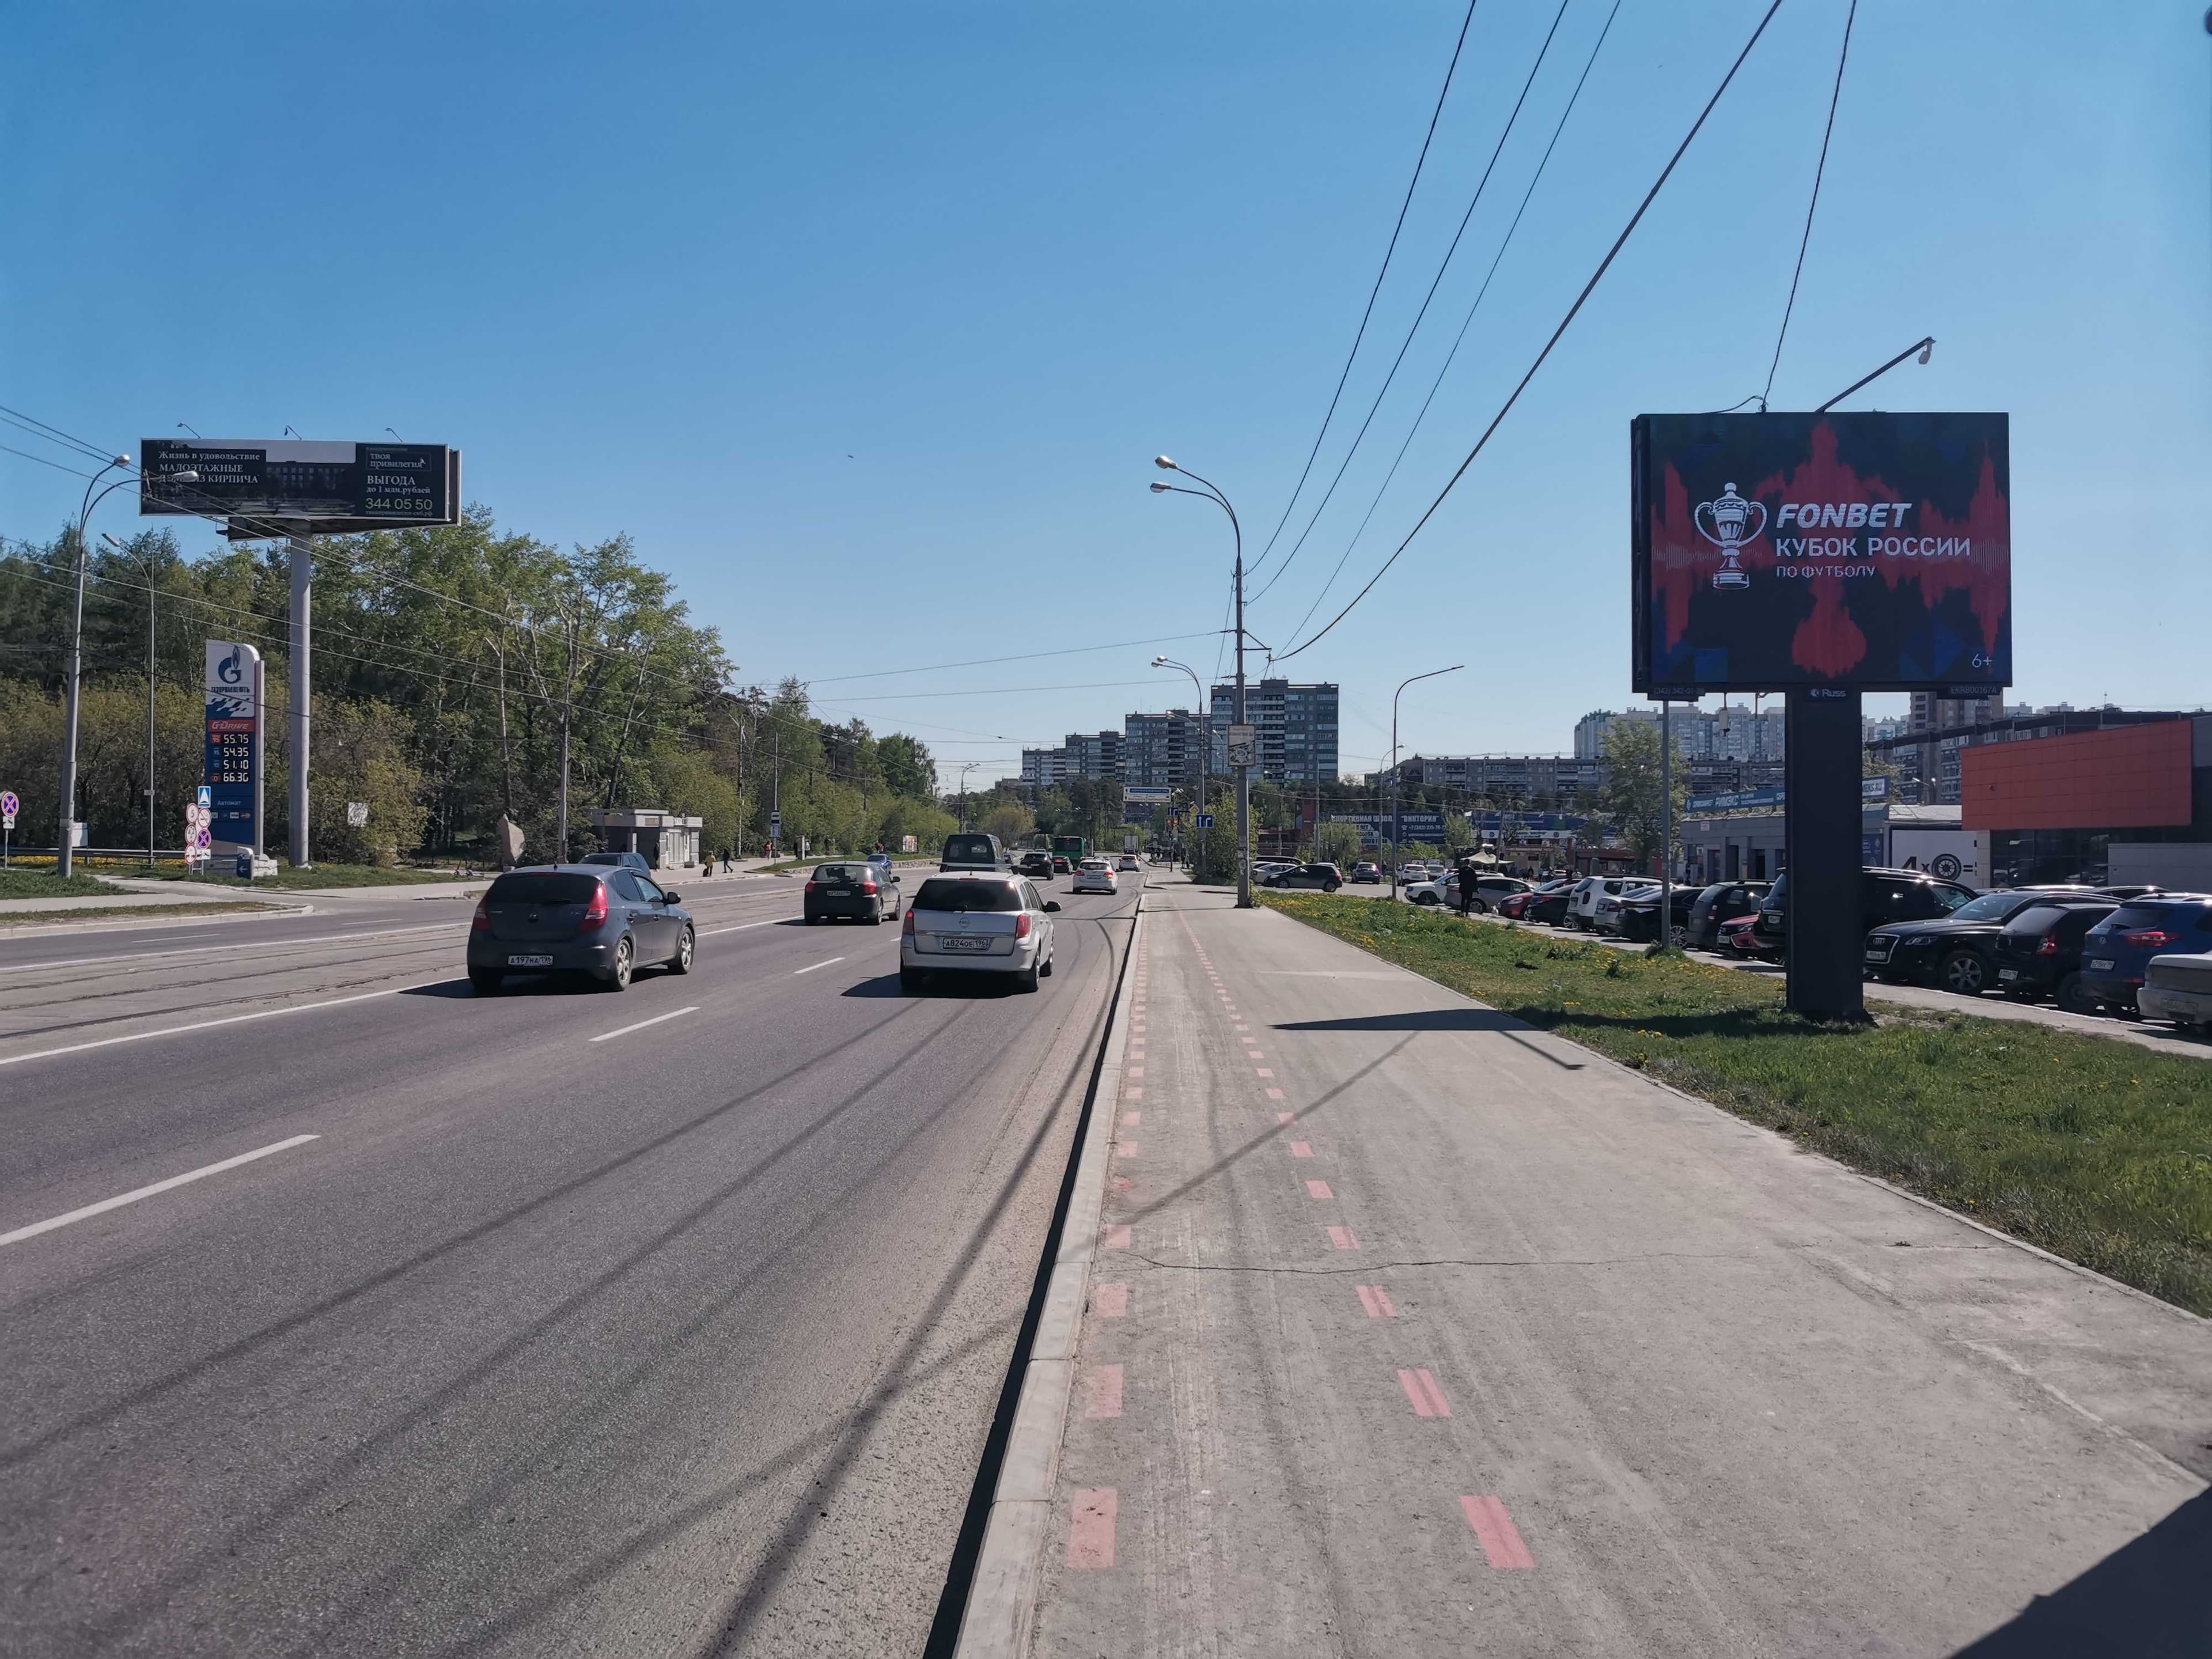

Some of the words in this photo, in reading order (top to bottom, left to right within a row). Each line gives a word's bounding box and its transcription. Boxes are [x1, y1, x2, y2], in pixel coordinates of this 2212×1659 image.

[158, 451, 190, 459] Жизнь
[199, 453, 260, 461] удовольствие
[159, 463, 244, 472] МАЛОЭТАЖНЫЕ
[209, 475, 258, 483] КИРПИЧА
[367, 475, 415, 486] ВЫГОДА
[365, 498, 391, 509] 344
[395, 498, 412, 510] 05
[415, 499, 433, 510] 50
[1777, 503, 1912, 528] FONBET
[1776, 537, 1857, 557] КУБОК
[1868, 537, 1970, 556] РОССИИ
[1777, 566, 1798, 578] ПО
[1801, 565, 1876, 578] ФУТБОЛУ
[1972, 653, 1993, 668] 6+
[1822, 689, 1847, 698] Russ
[224, 734, 249, 744] 55.75
[224, 747, 249, 756] 54.35
[224, 760, 249, 769] 51.10
